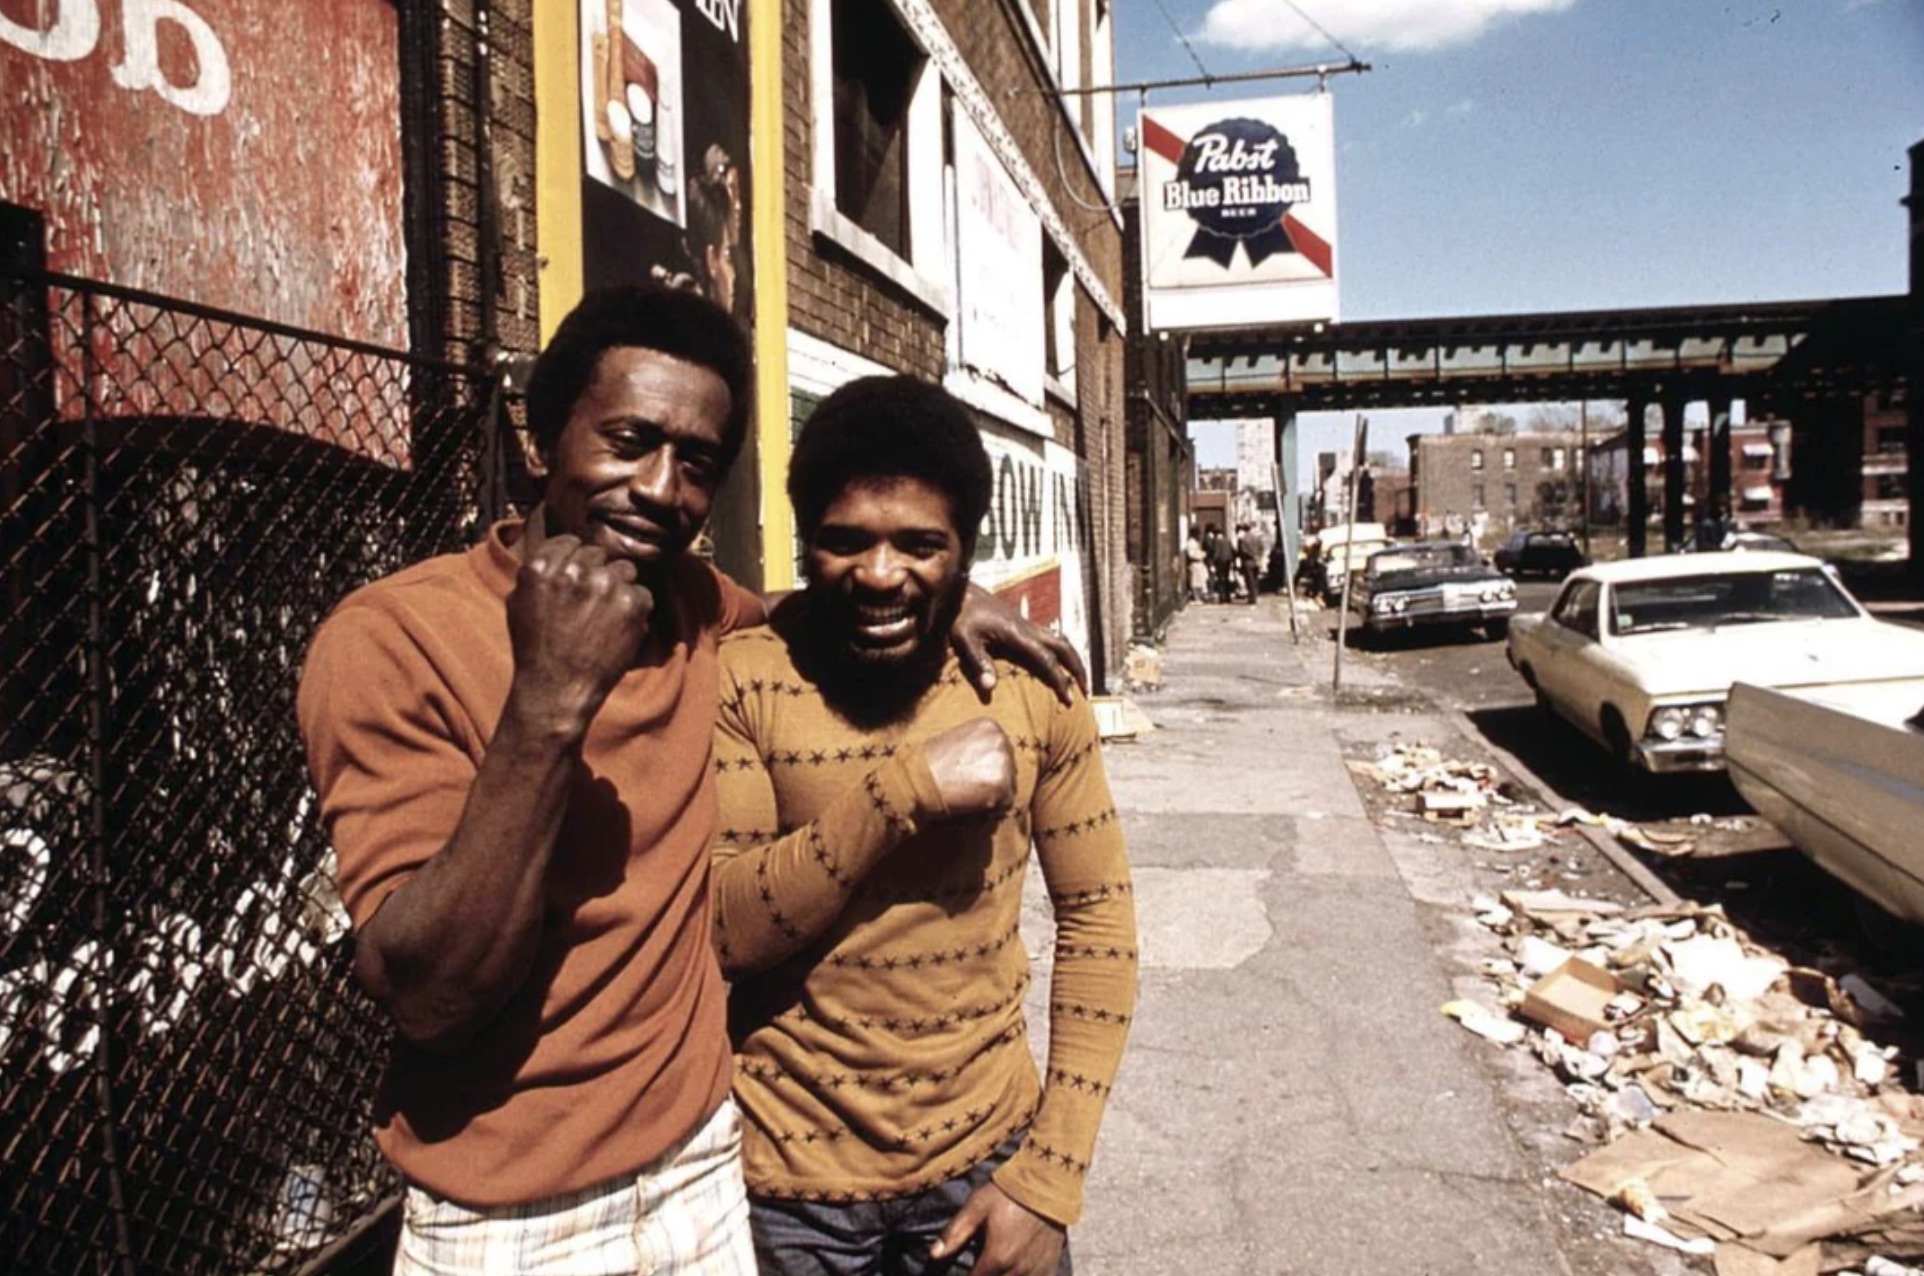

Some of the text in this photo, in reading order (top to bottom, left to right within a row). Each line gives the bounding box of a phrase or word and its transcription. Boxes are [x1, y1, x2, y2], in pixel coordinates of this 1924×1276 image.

[1193, 133, 1279, 174] Pabst
[1165, 174, 1309, 210] Blue Ribbon
